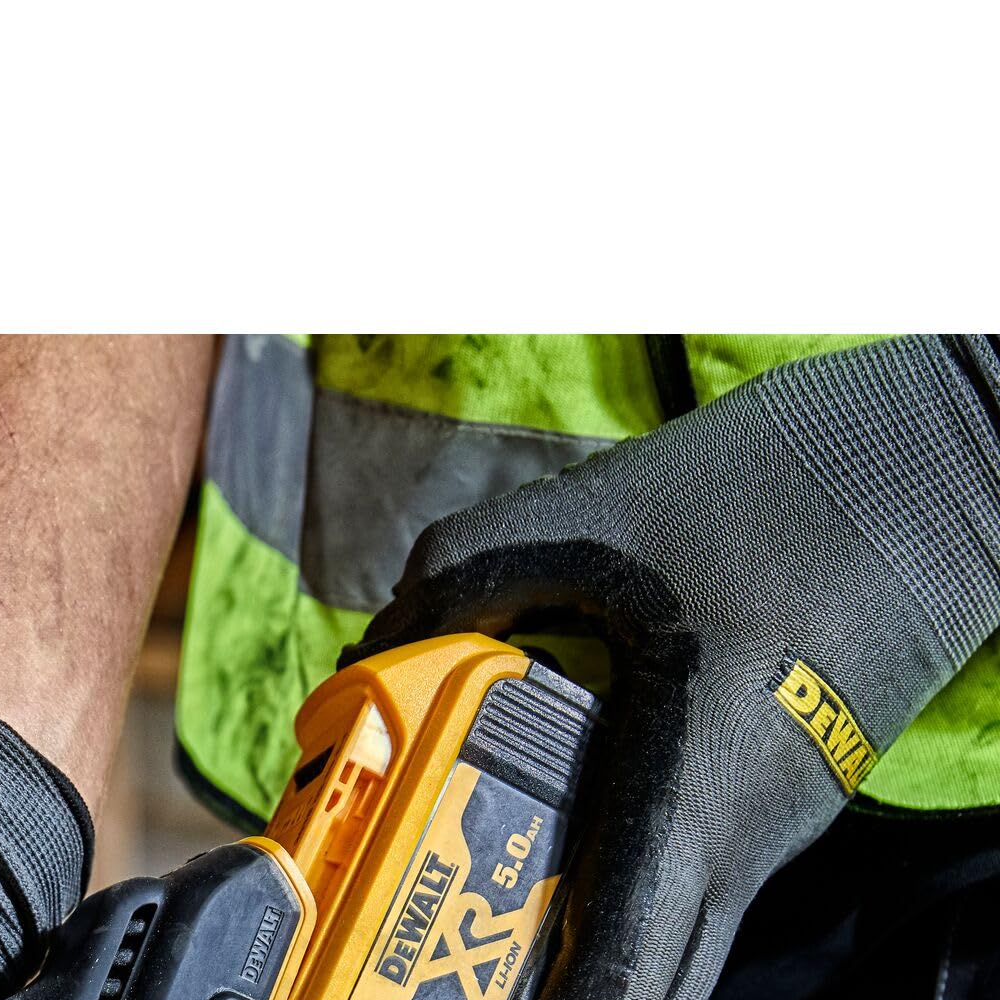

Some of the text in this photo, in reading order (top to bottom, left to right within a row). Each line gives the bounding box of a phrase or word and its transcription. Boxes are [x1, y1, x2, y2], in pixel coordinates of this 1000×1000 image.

[775, 664, 873, 786] DEWAL
[241, 906, 283, 983] DEWALT
[378, 853, 454, 986] DEWALT
[495, 941, 522, 989] LI-ION
